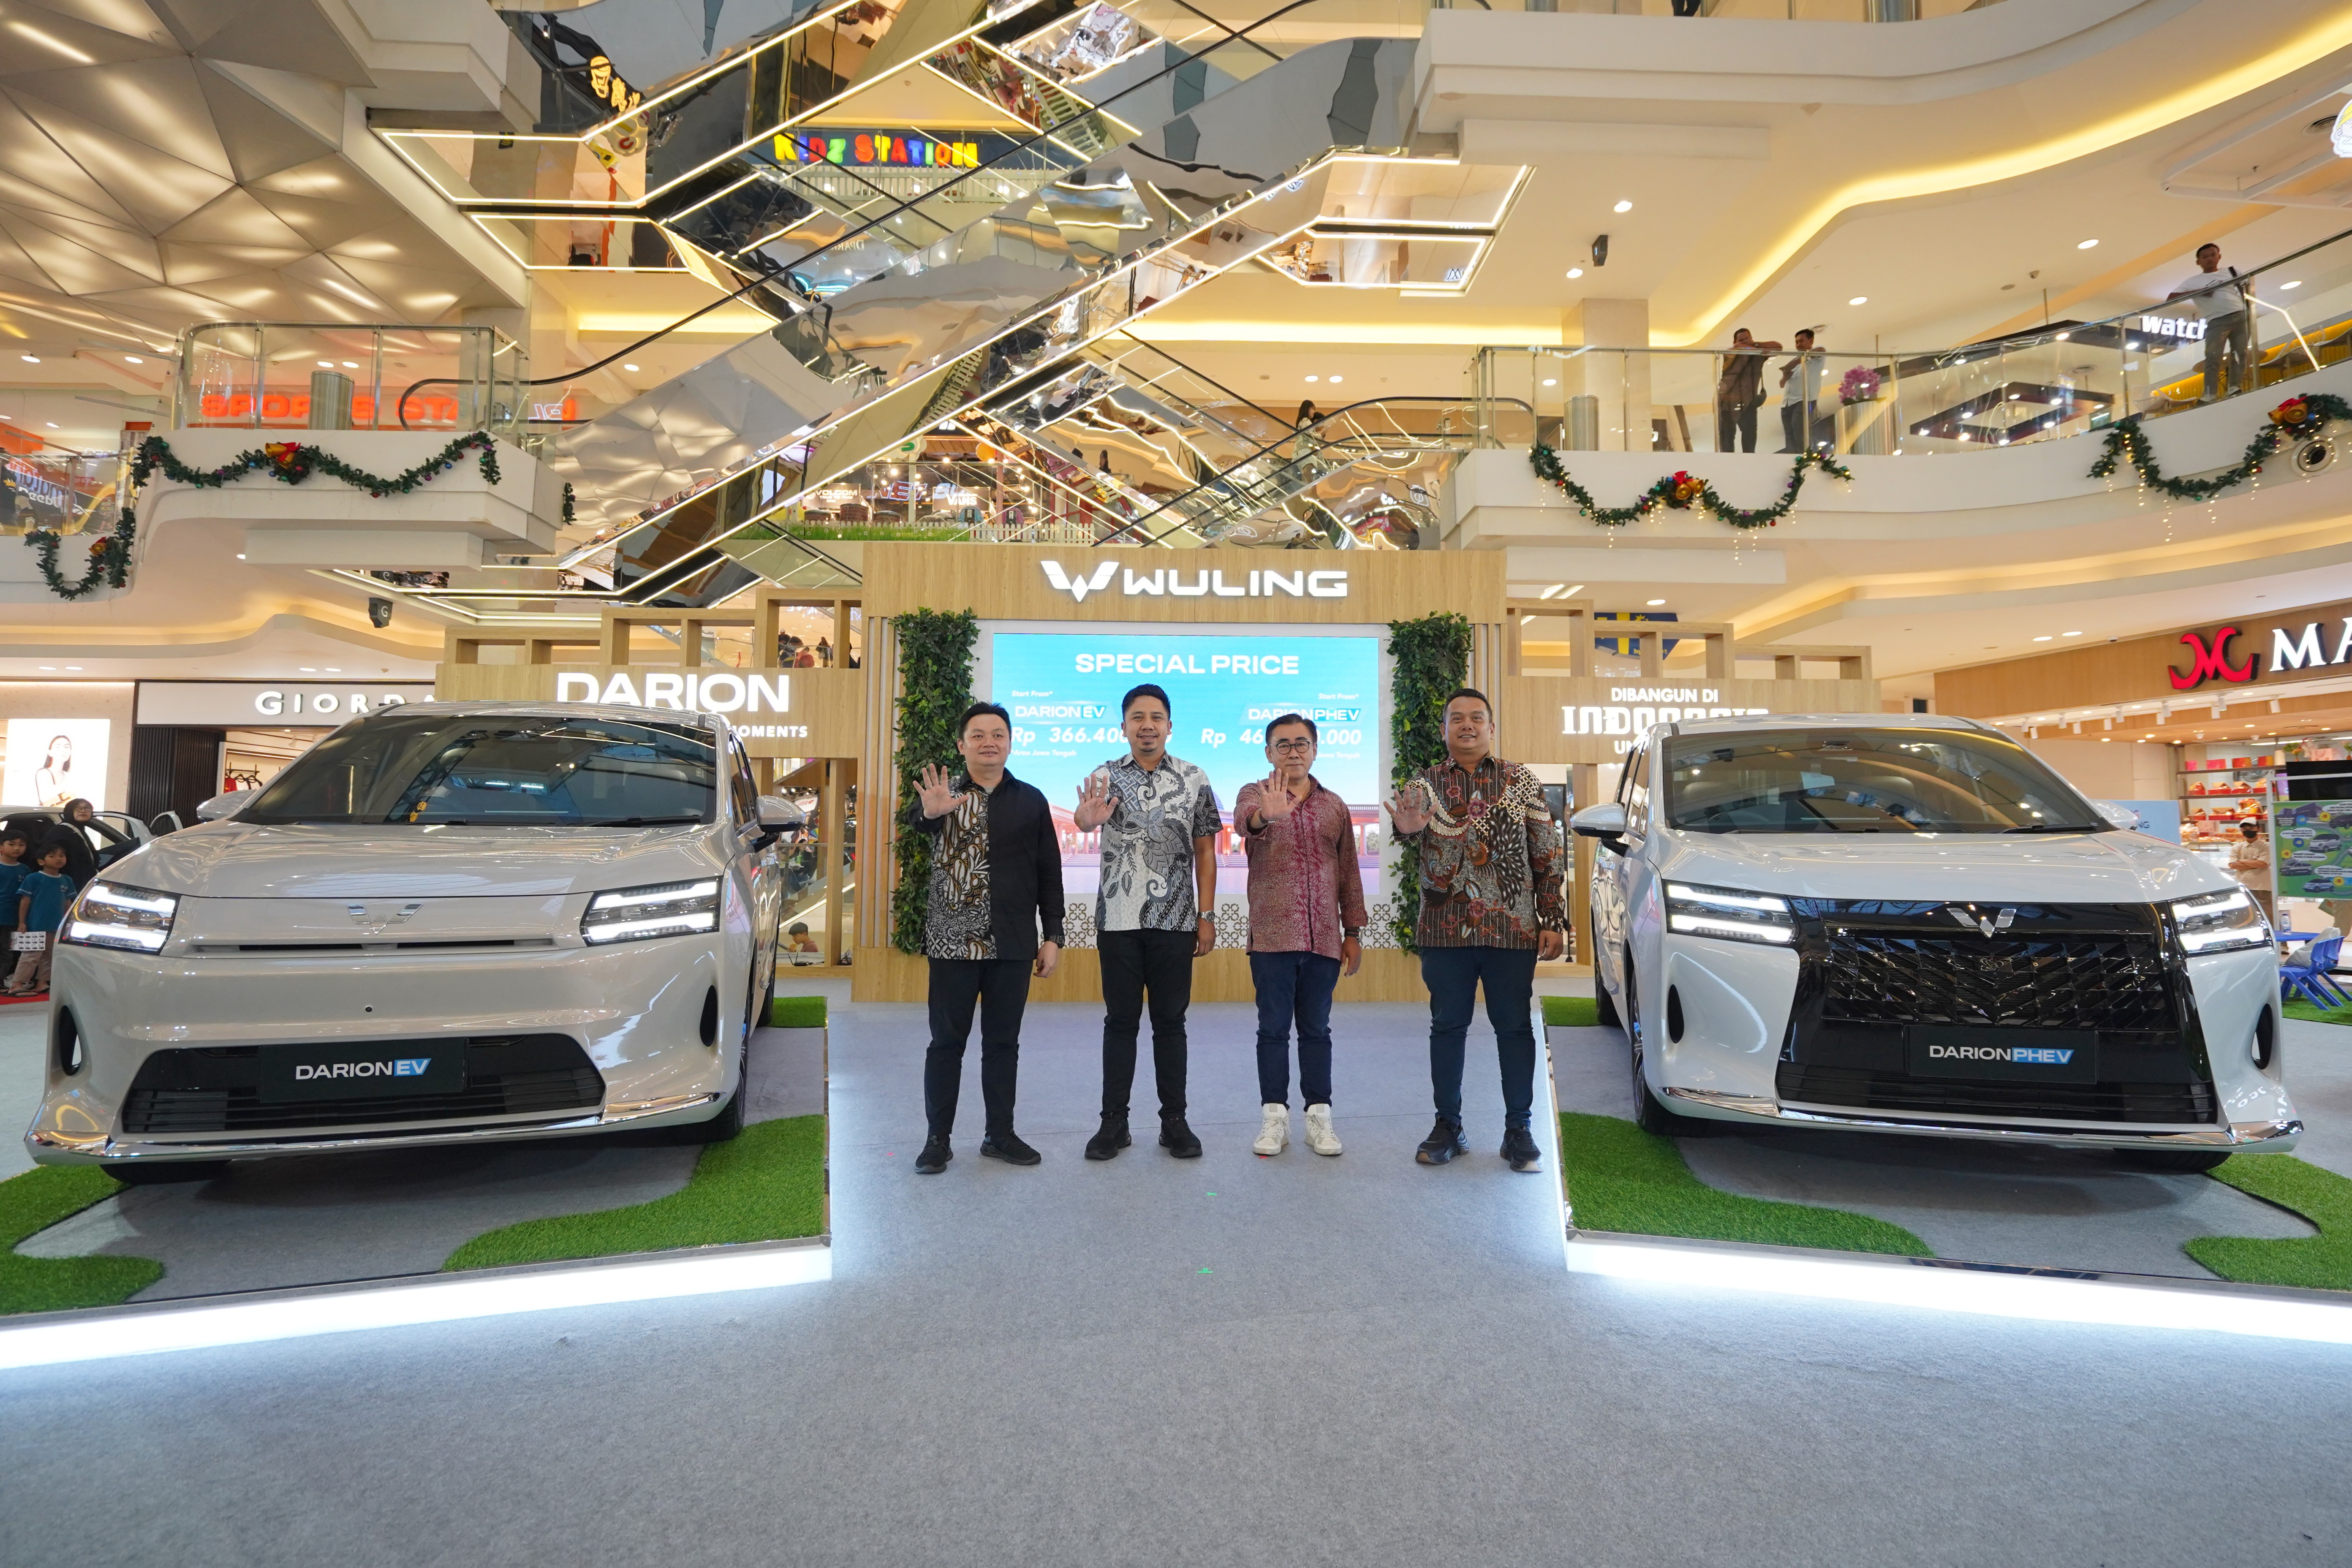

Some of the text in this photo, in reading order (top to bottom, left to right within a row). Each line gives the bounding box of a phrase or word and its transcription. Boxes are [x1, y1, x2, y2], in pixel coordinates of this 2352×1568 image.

[774, 133, 978, 167] KIDZ STATION
[201, 394, 375, 419] SPORS
[946, 494, 977, 505] VANS
[1123, 568, 1347, 597] WULING
[381, 606, 388, 617] G
[1075, 653, 1299, 674] SPECIAL PRICE
[557, 672, 789, 713] DARION
[1611, 688, 1718, 703] DIBANGUN DI
[1011, 726, 1036, 747] Rp
[1201, 728, 1226, 748] Rp
[1052, 750, 1077, 758] Tengah
[1336, 752, 1360, 760] Tengah
